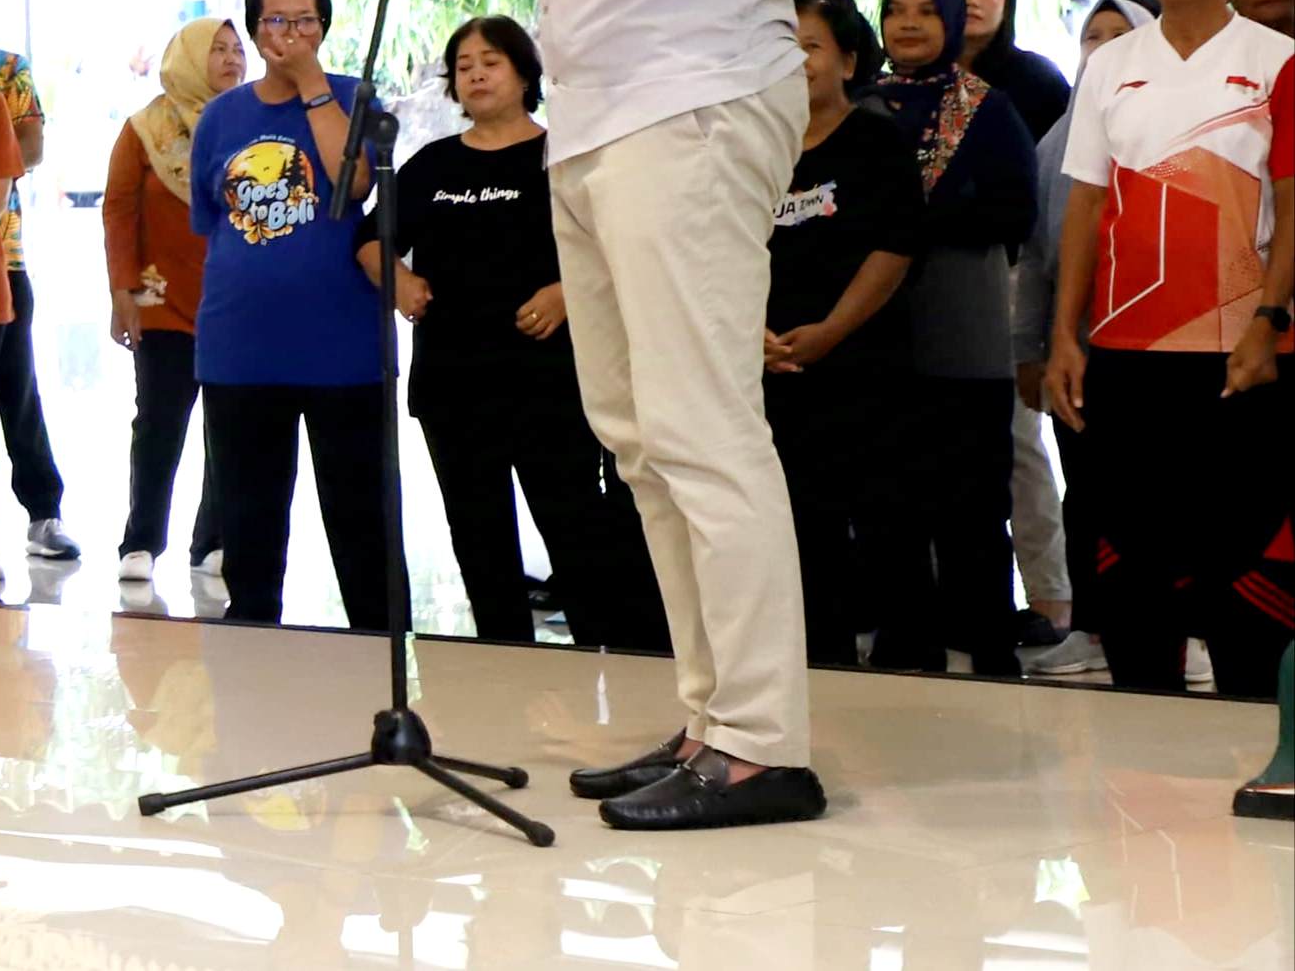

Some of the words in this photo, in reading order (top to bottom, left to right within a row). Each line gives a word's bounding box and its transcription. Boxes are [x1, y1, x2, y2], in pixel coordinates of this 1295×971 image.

[432, 189, 477, 205] Simple
[479, 187, 521, 201] things
[248, 202, 268, 222] to
[268, 197, 315, 230] Bali
